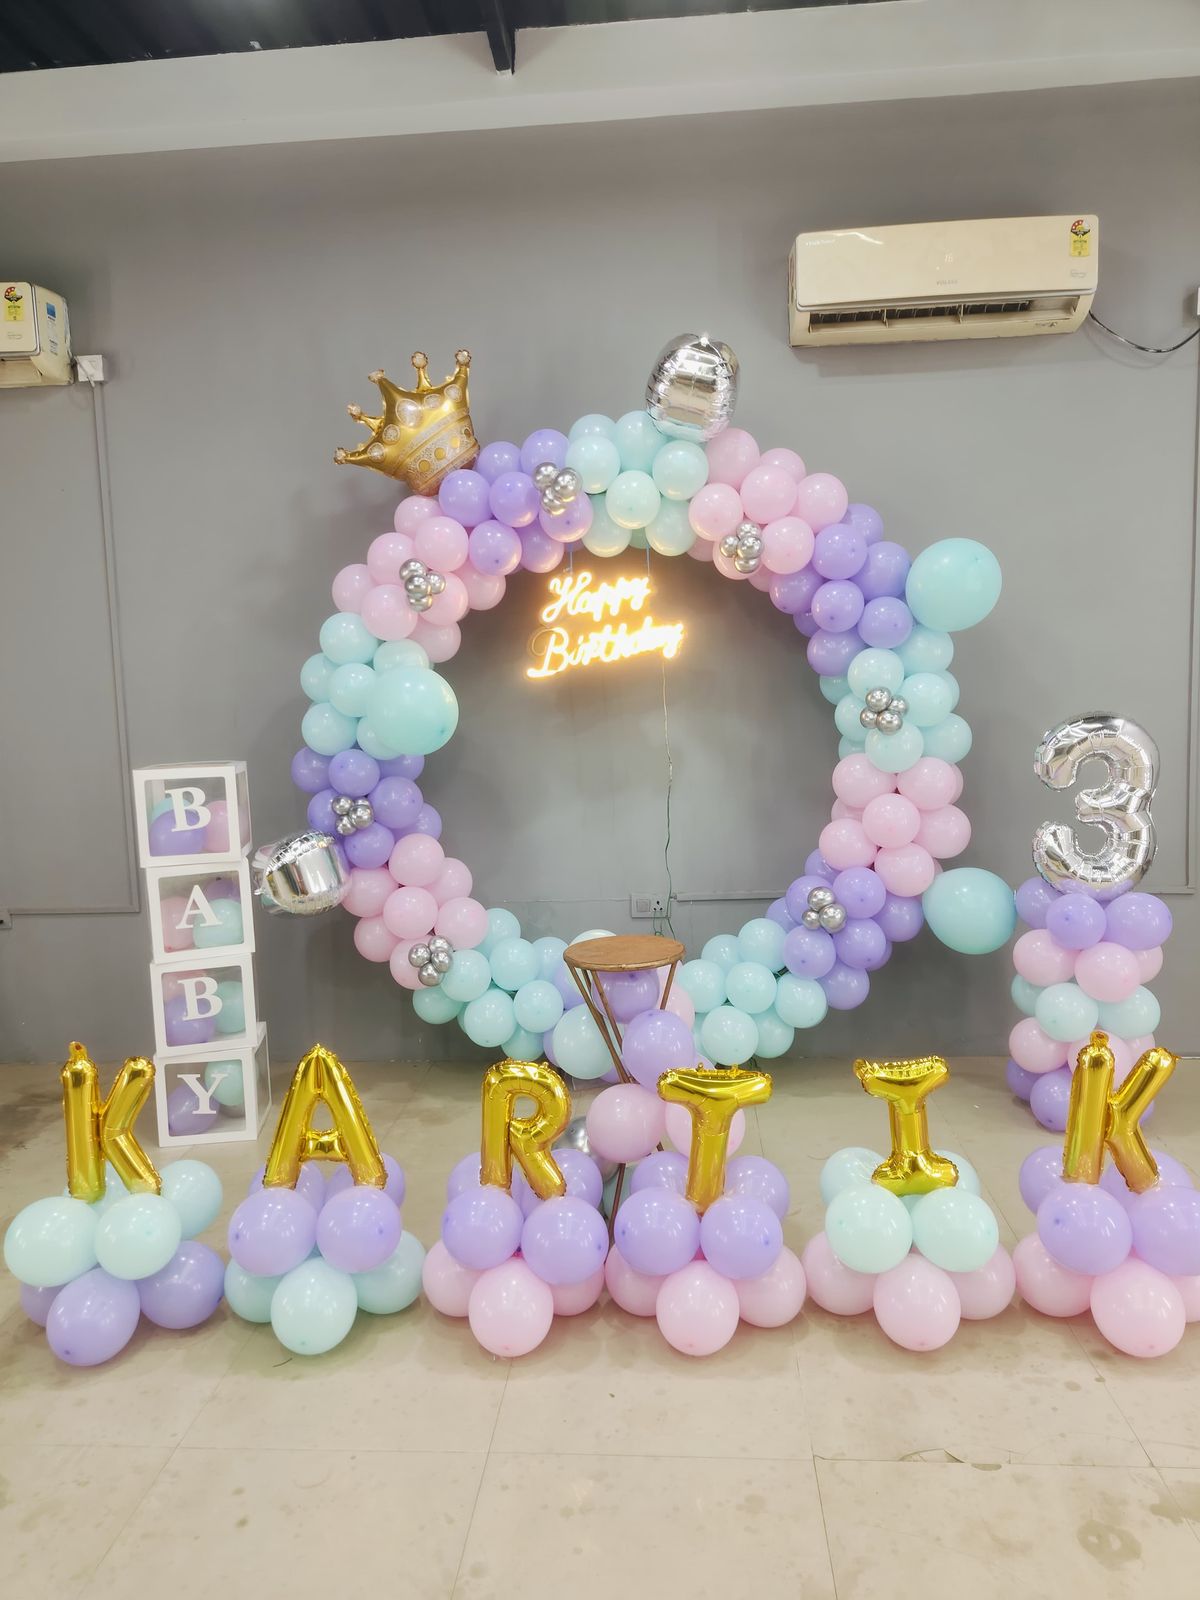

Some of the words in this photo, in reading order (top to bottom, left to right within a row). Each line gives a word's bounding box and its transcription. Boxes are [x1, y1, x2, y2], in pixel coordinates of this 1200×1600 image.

[541, 571, 651, 622] Happy
[527, 616, 684, 678] Birthday
[1032, 712, 1160, 898] 3
